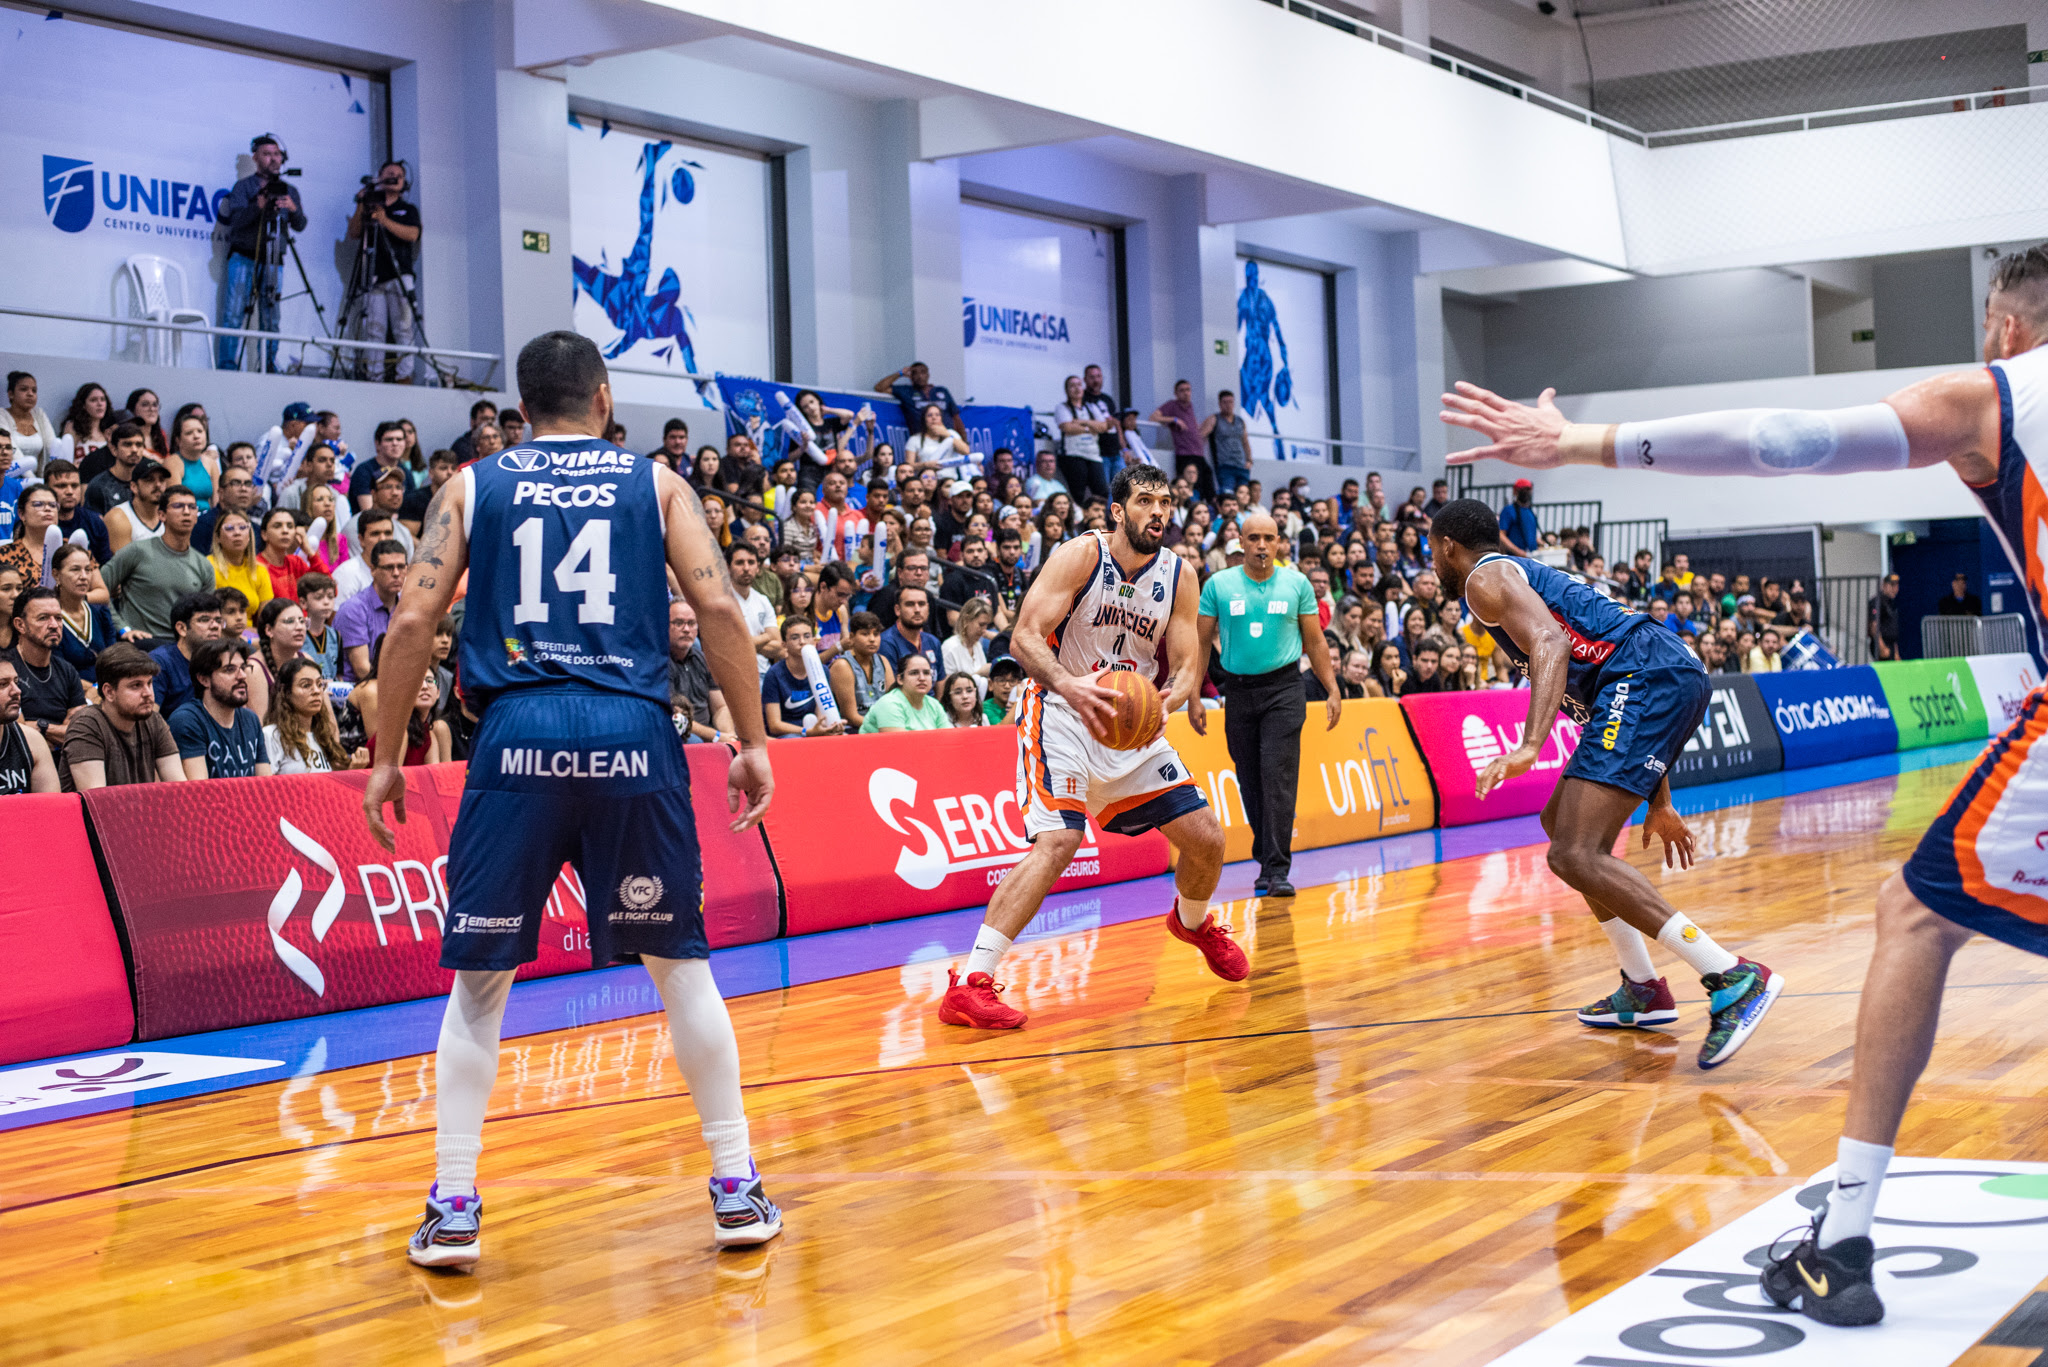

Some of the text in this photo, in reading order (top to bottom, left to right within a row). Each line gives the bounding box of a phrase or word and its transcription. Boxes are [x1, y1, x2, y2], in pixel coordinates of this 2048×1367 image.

[101, 171, 232, 223] UNIFAC
[550, 450, 636, 468] VINAC
[513, 481, 618, 508] PECOS
[512, 517, 617, 625] 14
[573, 656, 595, 665] DOS
[1601, 682, 1630, 751] DESKTOP
[501, 747, 648, 778] MILCLEAN
[1066, 777, 1077, 795] 11
[624, 911, 650, 921] FIGHT
[650, 912, 674, 922] CLUB
